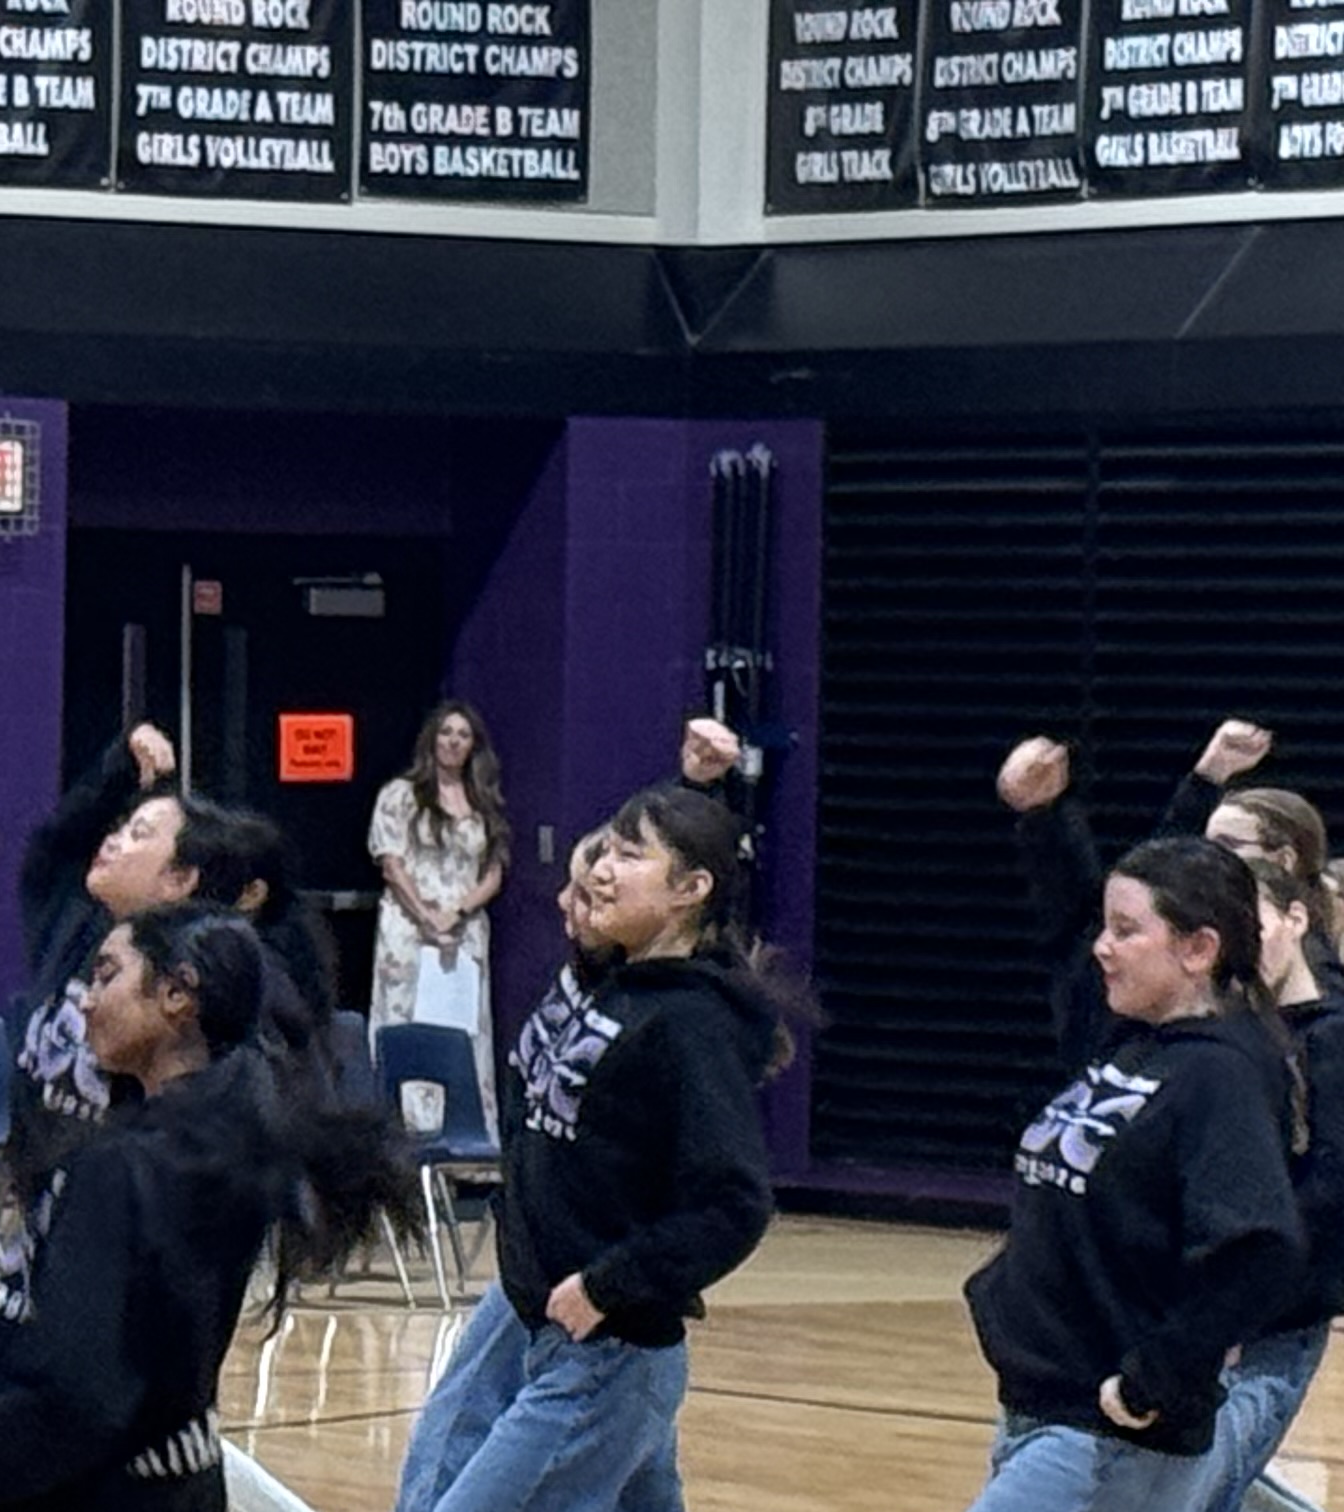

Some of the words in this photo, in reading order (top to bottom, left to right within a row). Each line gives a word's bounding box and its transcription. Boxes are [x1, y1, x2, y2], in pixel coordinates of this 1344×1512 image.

[166, 0, 245, 26] ROUND
[252, 0, 309, 29] ROCK
[401, 1, 481, 32] ROUND
[486, 3, 552, 35] ROCK
[950, 1, 1010, 32] ROUND
[1012, 0, 1061, 28] ROCK
[141, 36, 241, 72] DISTRICT
[246, 43, 331, 78] CHAMPS
[370, 39, 479, 74] DISTRICT
[484, 45, 579, 78] CHAMPS
[934, 53, 999, 88] DISTRICT
[1002, 46, 1077, 83] CHAMPS
[1105, 34, 1170, 70] DISTRICT
[1173, 27, 1242, 66] CHAMPS
[780, 57, 842, 90] DISTRICT
[844, 53, 913, 88] CHAMPS
[13, 74, 29, 107] B
[35, 75, 95, 109] TEAM
[177, 86, 251, 121] GRADE
[254, 90, 273, 122] A
[277, 91, 334, 126] TEAM
[1127, 81, 1182, 118] GRADE
[1201, 78, 1244, 113] TEAM
[369, 101, 406, 132] 7th
[411, 102, 491, 136] GRADE
[496, 105, 513, 136] B
[518, 106, 580, 140] TEAM
[959, 106, 1012, 140] GRADE
[1016, 106, 1030, 137] A
[1032, 103, 1076, 136] TEAM
[137, 131, 200, 168] GIRLS
[205, 135, 334, 173] VOLLEYBALL
[369, 142, 429, 175] BOYS
[434, 146, 580, 181] BASKETBALL
[841, 149, 893, 181] TRACK
[1095, 132, 1144, 168] GIRLS
[1147, 127, 1242, 165] BASKETBALL
[930, 162, 976, 195] GIRLS
[979, 157, 1080, 193] VOLLEYBALL
